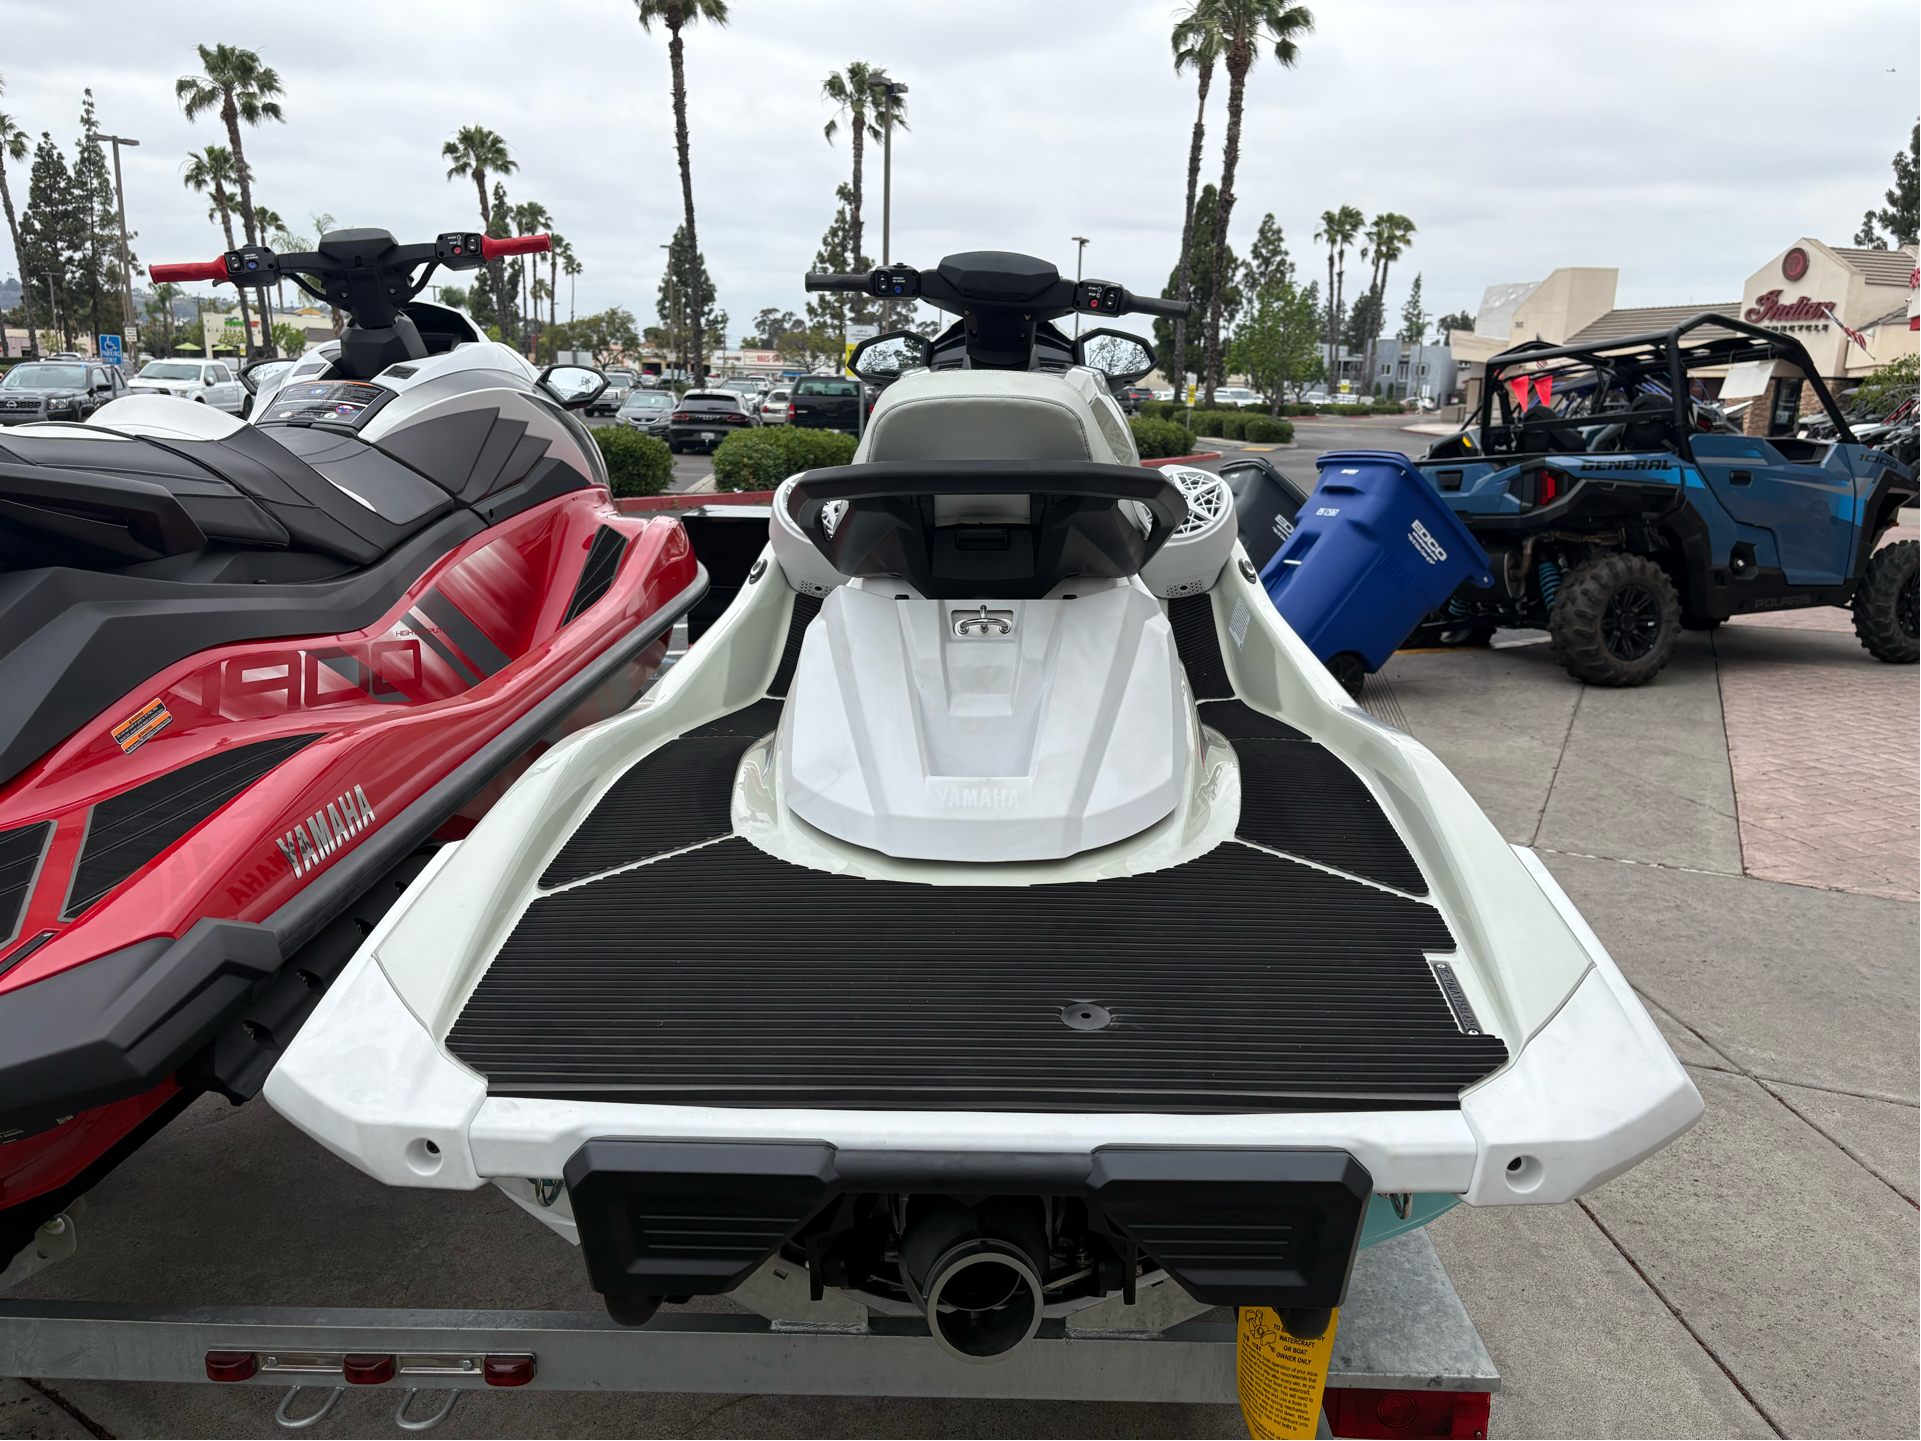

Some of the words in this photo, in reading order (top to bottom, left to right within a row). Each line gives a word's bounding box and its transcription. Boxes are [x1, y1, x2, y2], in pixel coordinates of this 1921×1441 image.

[1744, 289, 1836, 323] Indian
[1580, 460, 1672, 471] GENERAL
[1859, 454, 1898, 470] 1000
[1274, 514, 1294, 534] ED
[1410, 519, 1448, 562] EDCO
[1754, 594, 1811, 609] POLARIS
[937, 788, 1020, 808] YAMAHA
[275, 784, 376, 879] YAMAHA
[1279, 1335, 1315, 1348] WATERCRAFT
[1276, 1352, 1297, 1362] OWNER
[1293, 1347, 1307, 1355] BOAT
[1280, 1372, 1307, 1381] recommends
[1284, 1405, 1308, 1415] mechanism
